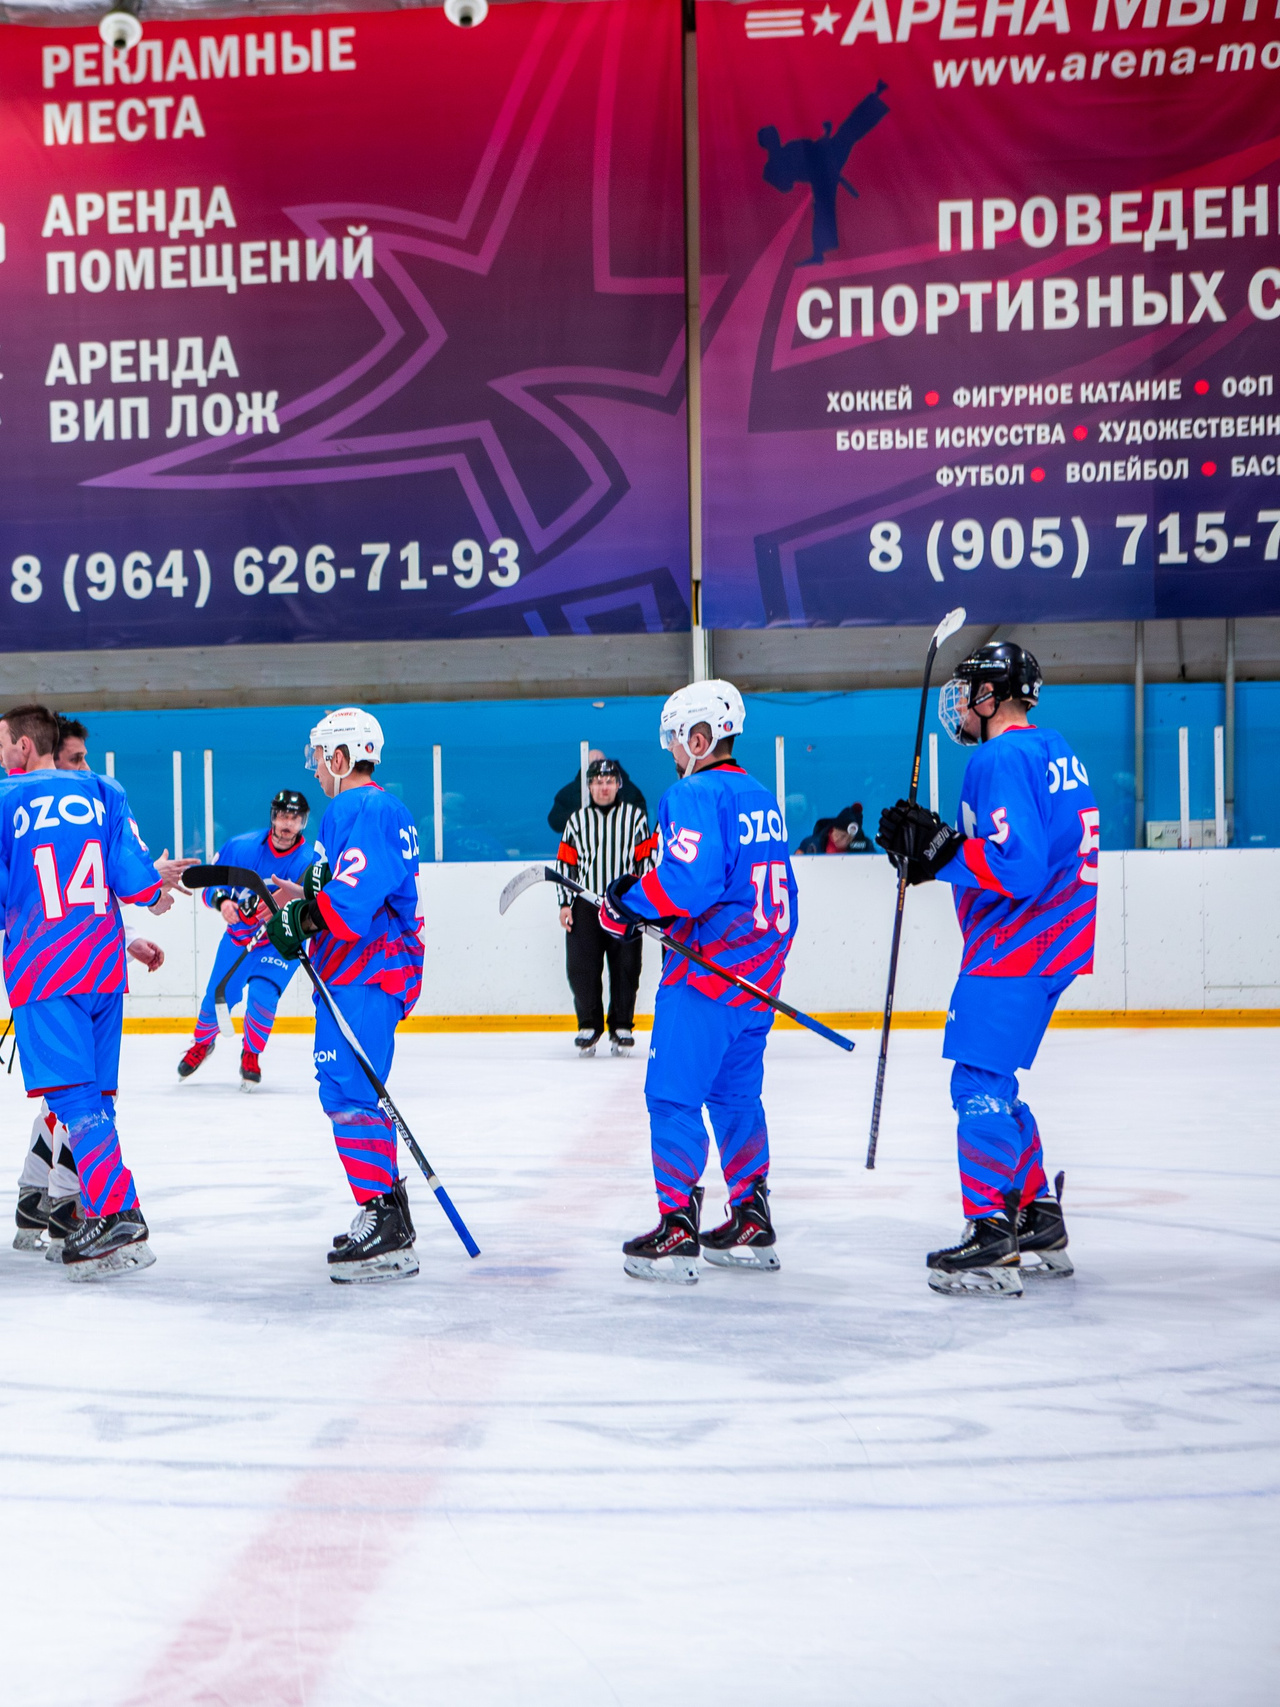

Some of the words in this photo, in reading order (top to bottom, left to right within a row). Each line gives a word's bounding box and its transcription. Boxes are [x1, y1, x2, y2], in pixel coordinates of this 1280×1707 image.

[840, 0, 1070, 46] АРЕНА
[41, 27, 356, 89] РЕКЛАМНЫЕ
[933, 41, 1280, 89] www.arena-mo
[42, 95, 205, 146] МЕСТА
[41, 186, 236, 239] АРЕНДА
[937, 184, 1280, 252] ПРОВЕДЕН
[45, 226, 375, 295] ПОМЕЩЕНИЙ
[796, 270, 1227, 340] СПОРТИВНЫХ
[45, 336, 239, 387] АРЕНДА
[49, 397, 151, 443] ВИП
[166, 390, 280, 439] ЛОЖ
[827, 384, 913, 413] ХОККЕЙ
[952, 383, 1073, 409] ФИГУРНОЕ
[1079, 378, 1182, 404] КАТАНИЕ
[1221, 375, 1273, 399] ОФП
[836, 427, 928, 451] БОЕВЫЕ
[935, 423, 1066, 449] ИСКУССТВА
[936, 464, 1025, 488] ФУТБОЛ
[1066, 456, 1189, 483] ВОЛЕЙБОЛ
[1231, 454, 1280, 477] БАС
[868, 521, 903, 573] 8
[926, 516, 1090, 582] (905)
[1116, 508, 1280, 566] 715-7
[10, 555, 42, 604] 8
[62, 550, 210, 612] (964)
[233, 538, 522, 596] 626-71-93
[1047, 755, 1090, 794] OZO
[988, 807, 1010, 845] 5
[32, 839, 109, 922] 14
[750, 861, 791, 935] 15
[260, 956, 289, 970] OZON
[656, 1229, 685, 1253] CCM
[737, 1226, 755, 1245] CCM
